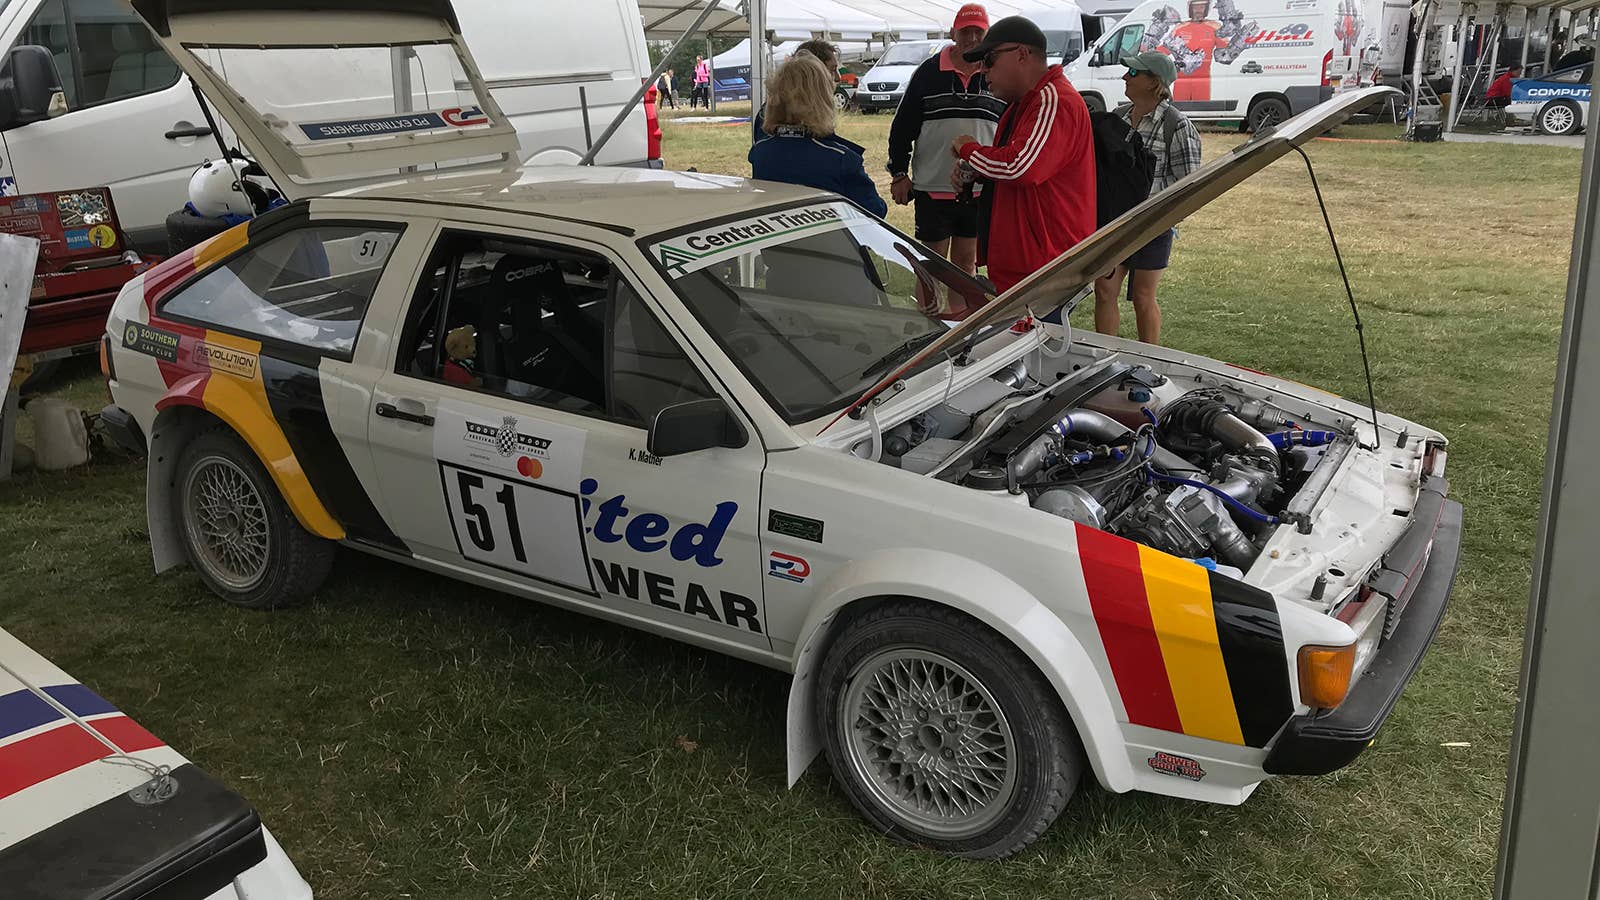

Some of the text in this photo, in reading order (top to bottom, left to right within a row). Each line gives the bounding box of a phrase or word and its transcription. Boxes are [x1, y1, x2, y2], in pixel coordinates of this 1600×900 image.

[1528, 88, 1592, 97] COMPUT
[320, 119, 412, 136] EXTINGUISHERS
[686, 207, 839, 250] Central Timber
[360, 240, 378, 256] 51
[505, 261, 553, 282] COBRA
[140, 328, 178, 347] SOUTHERN
[142, 344, 172, 358] CAR CLUB
[196, 346, 254, 368] REVOLUTION
[629, 448, 663, 466] K. Mather
[456, 471, 528, 564] 51
[592, 557, 764, 634] WEAR
[1157, 751, 1199, 769] POWER
